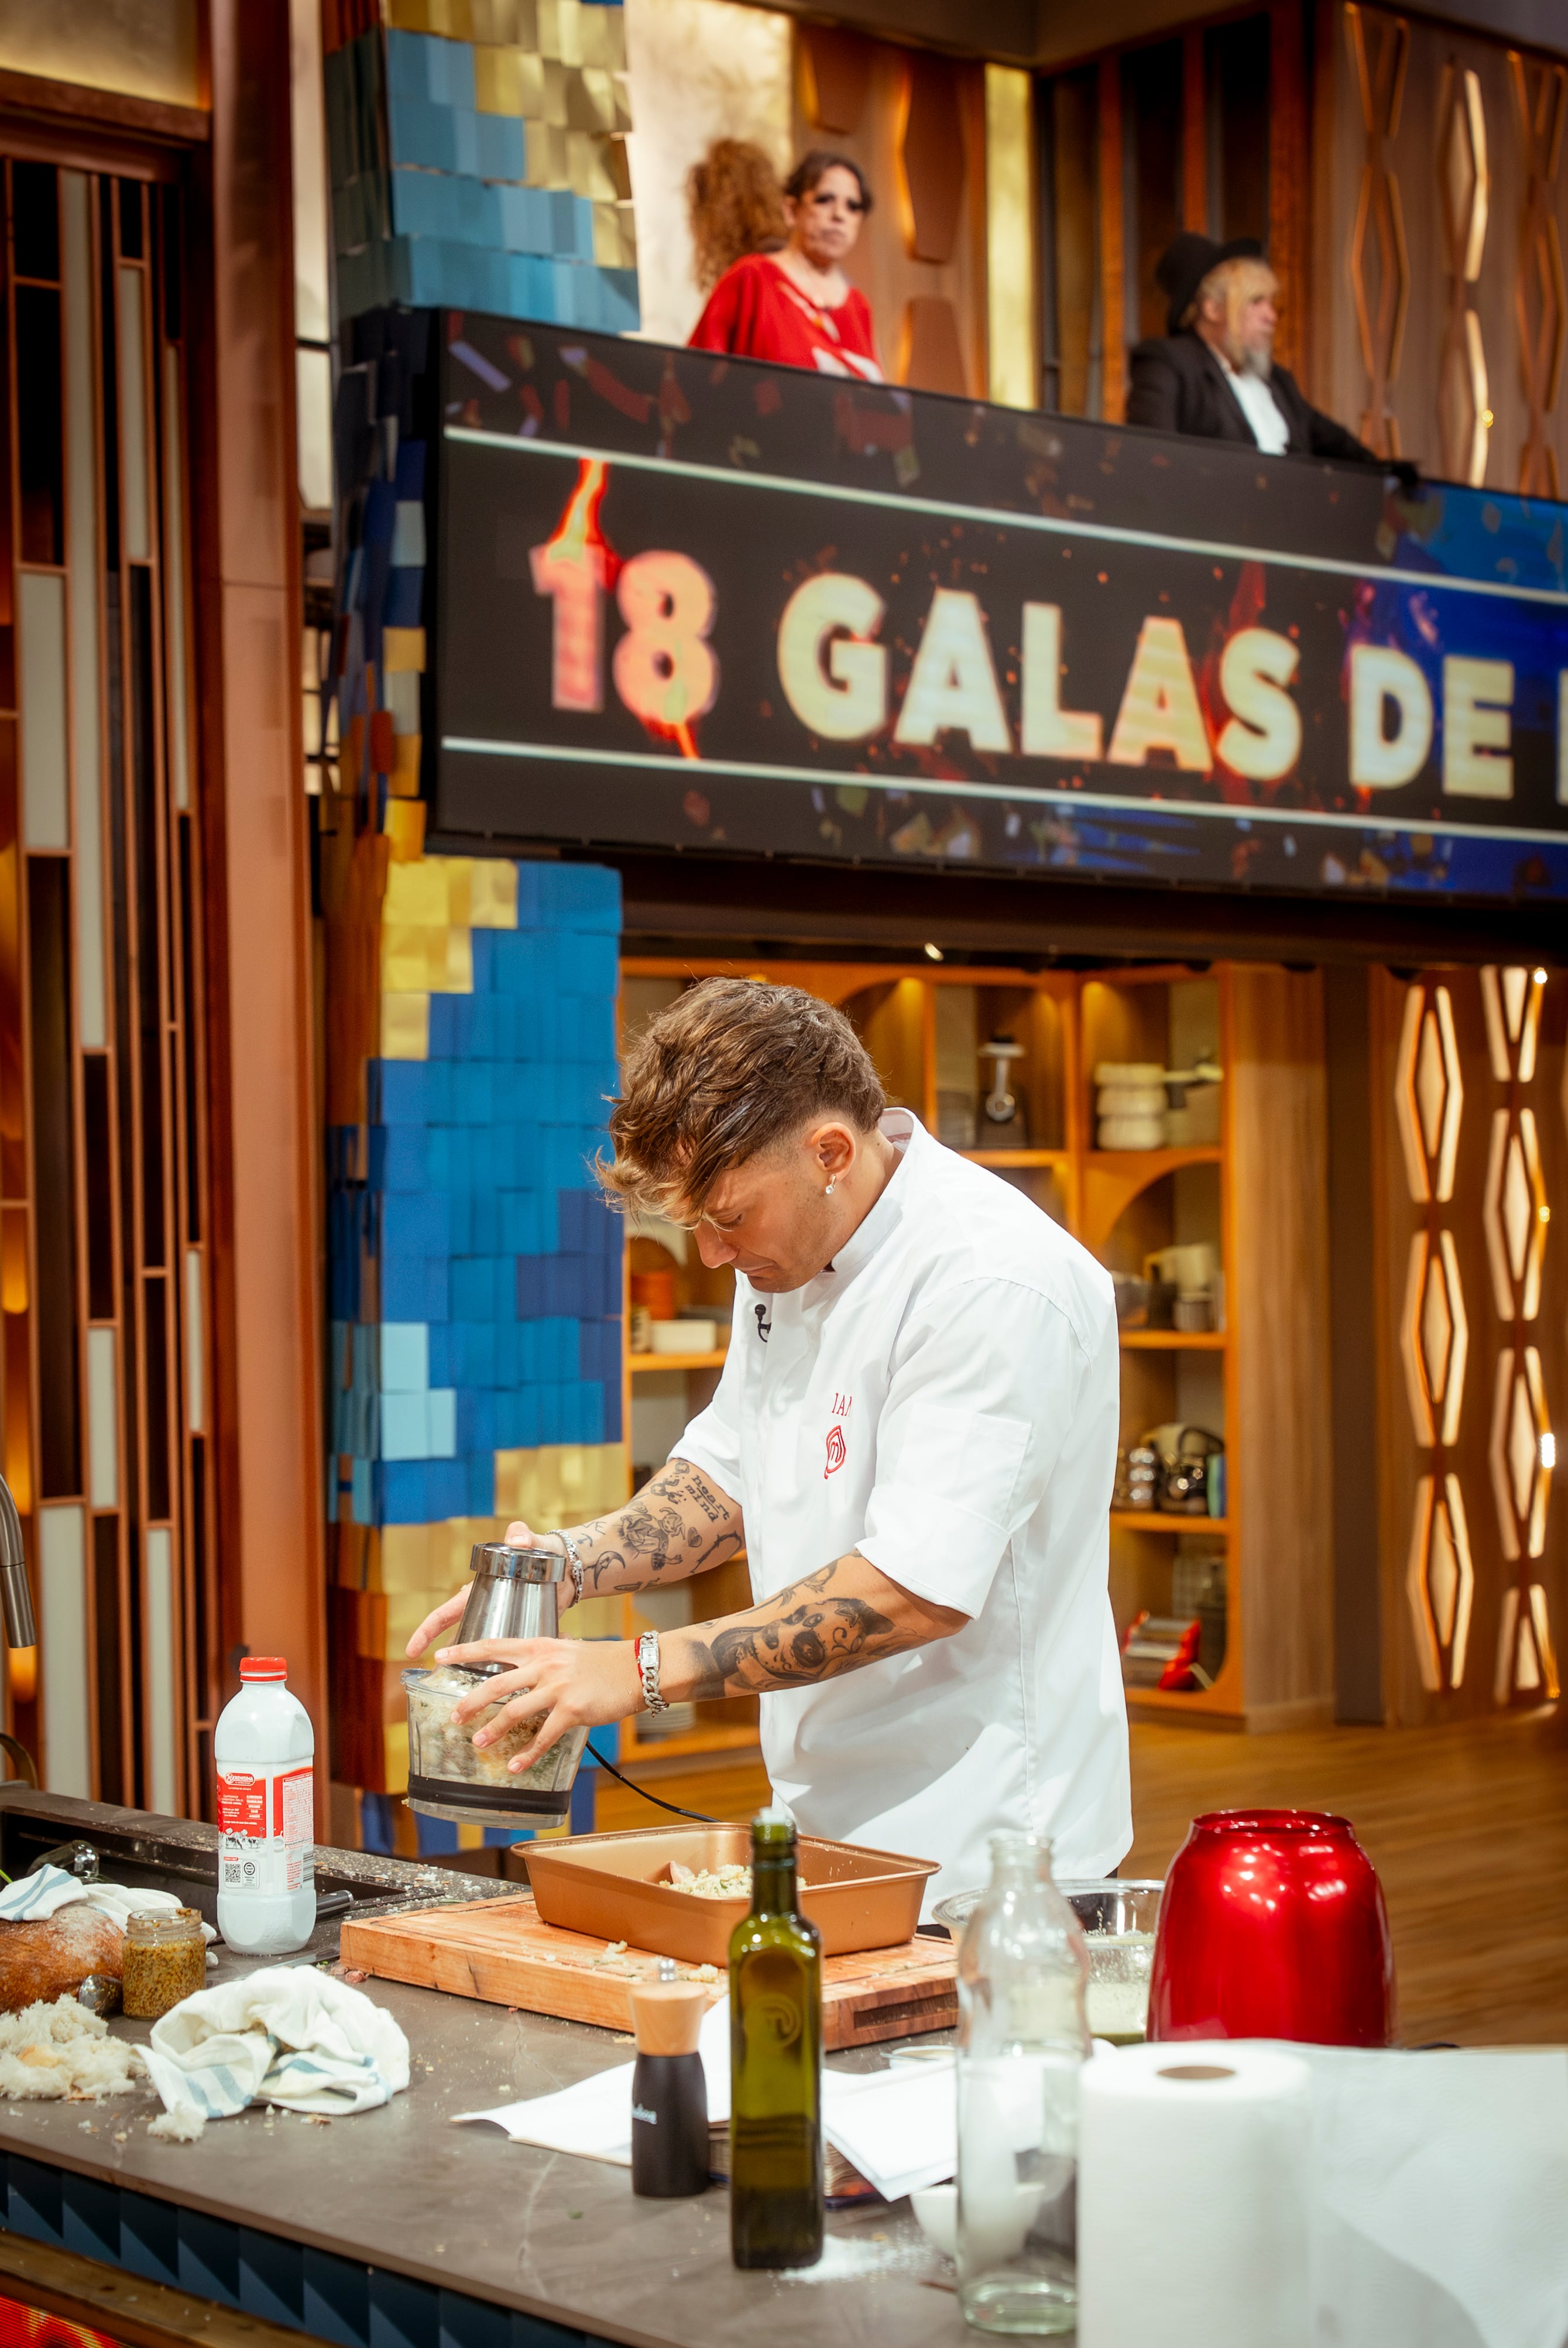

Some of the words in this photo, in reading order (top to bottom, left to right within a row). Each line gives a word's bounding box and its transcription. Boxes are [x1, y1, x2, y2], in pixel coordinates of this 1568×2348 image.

[529, 542, 722, 725] 18
[777, 571, 1302, 781] GALAS
[1349, 644, 1515, 801] DE
[684, 1485, 719, 1523] mind
[691, 1474, 730, 1520] heart
